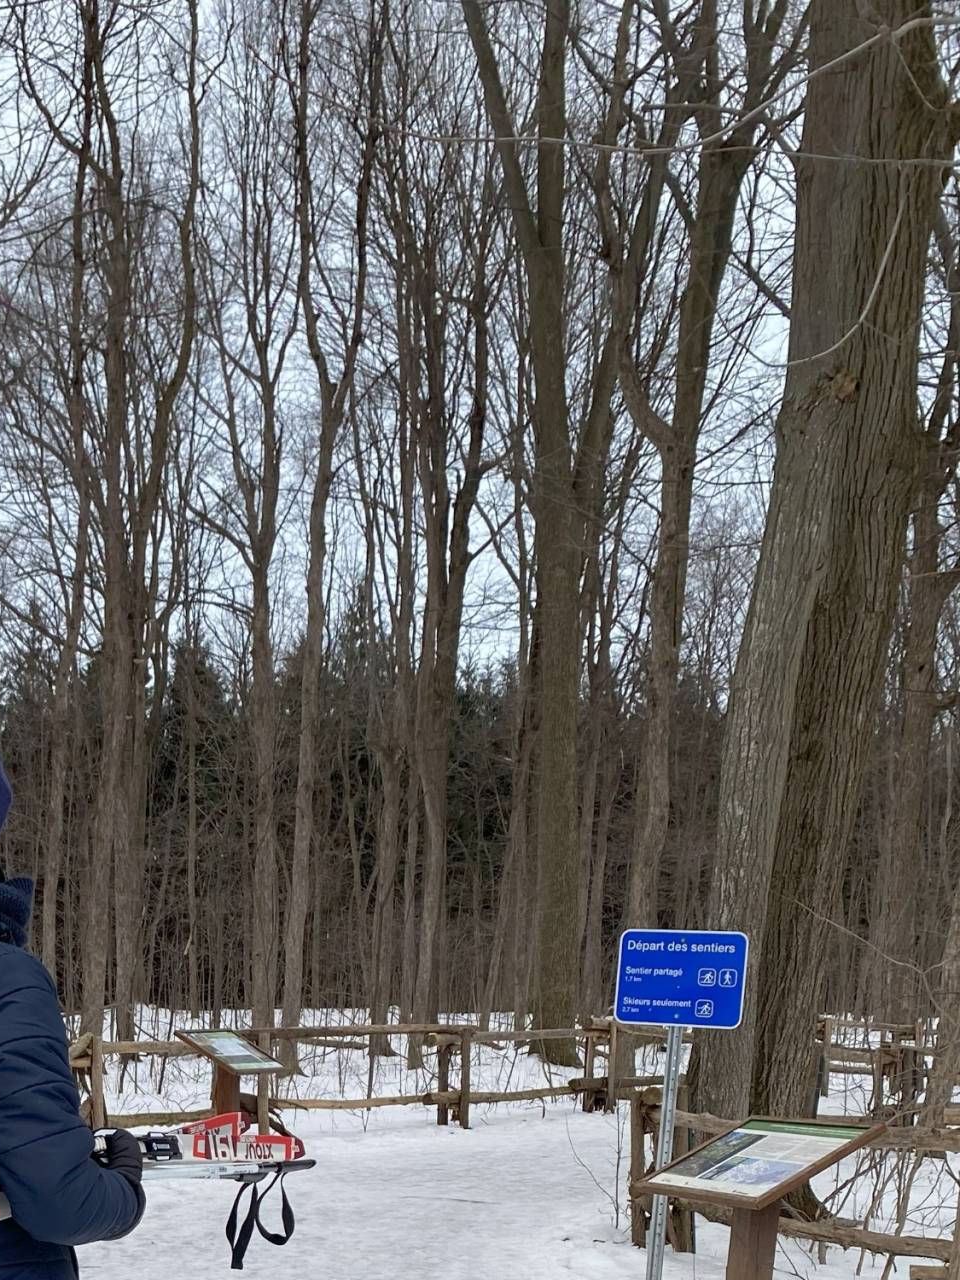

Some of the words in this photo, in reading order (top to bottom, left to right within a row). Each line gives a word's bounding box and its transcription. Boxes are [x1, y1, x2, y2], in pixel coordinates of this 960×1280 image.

[627, 939, 665, 952] Départ
[667, 940, 688, 951] des
[691, 942, 736, 953] sentiers
[625, 966, 652, 975] Sentier
[653, 967, 683, 978] partagé
[623, 996, 650, 1006] Skieurs
[652, 998, 692, 1008] seulement
